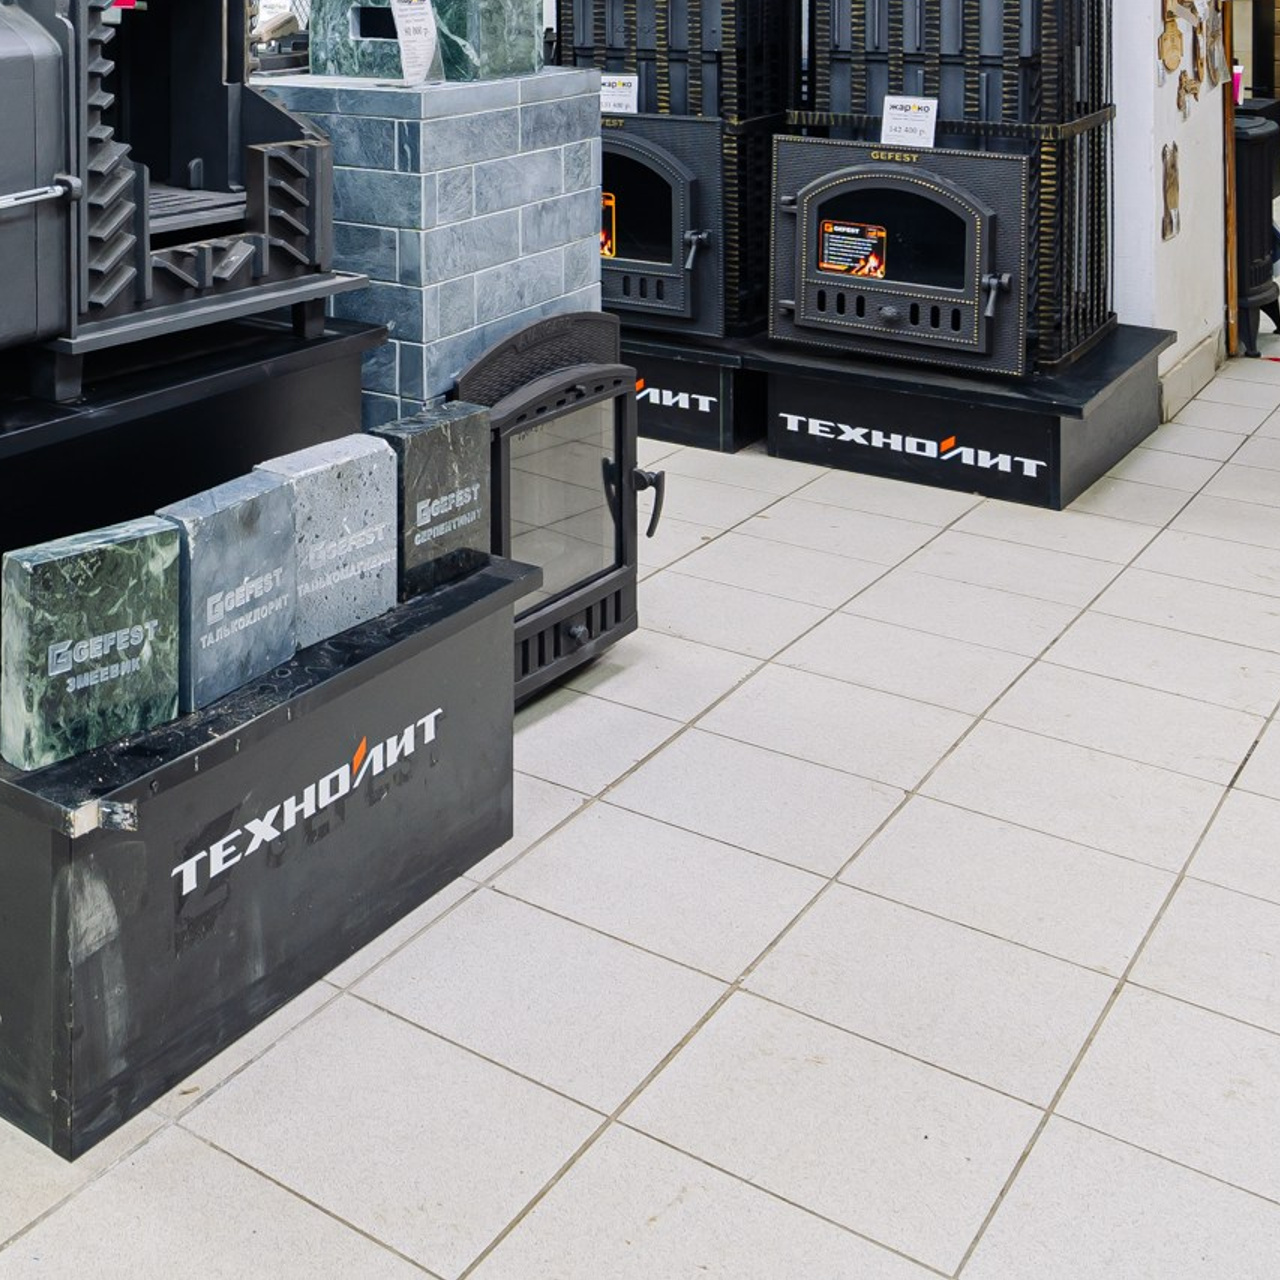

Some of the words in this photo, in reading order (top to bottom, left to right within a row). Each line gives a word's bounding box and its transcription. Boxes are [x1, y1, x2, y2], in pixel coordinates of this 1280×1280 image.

[871, 151, 919, 163] GEFEST
[778, 413, 1048, 478] ТЕХНОЛИТ
[431, 483, 481, 517] GEFEST
[224, 567, 283, 612] GEFEST
[73, 620, 158, 663] GEFEST
[200, 593, 289, 649] ТАЛЬКОХЛОРИТ
[66, 657, 141, 693] ЗМЕЕВИК
[170, 707, 443, 897] ТЕХНОЛИТ
